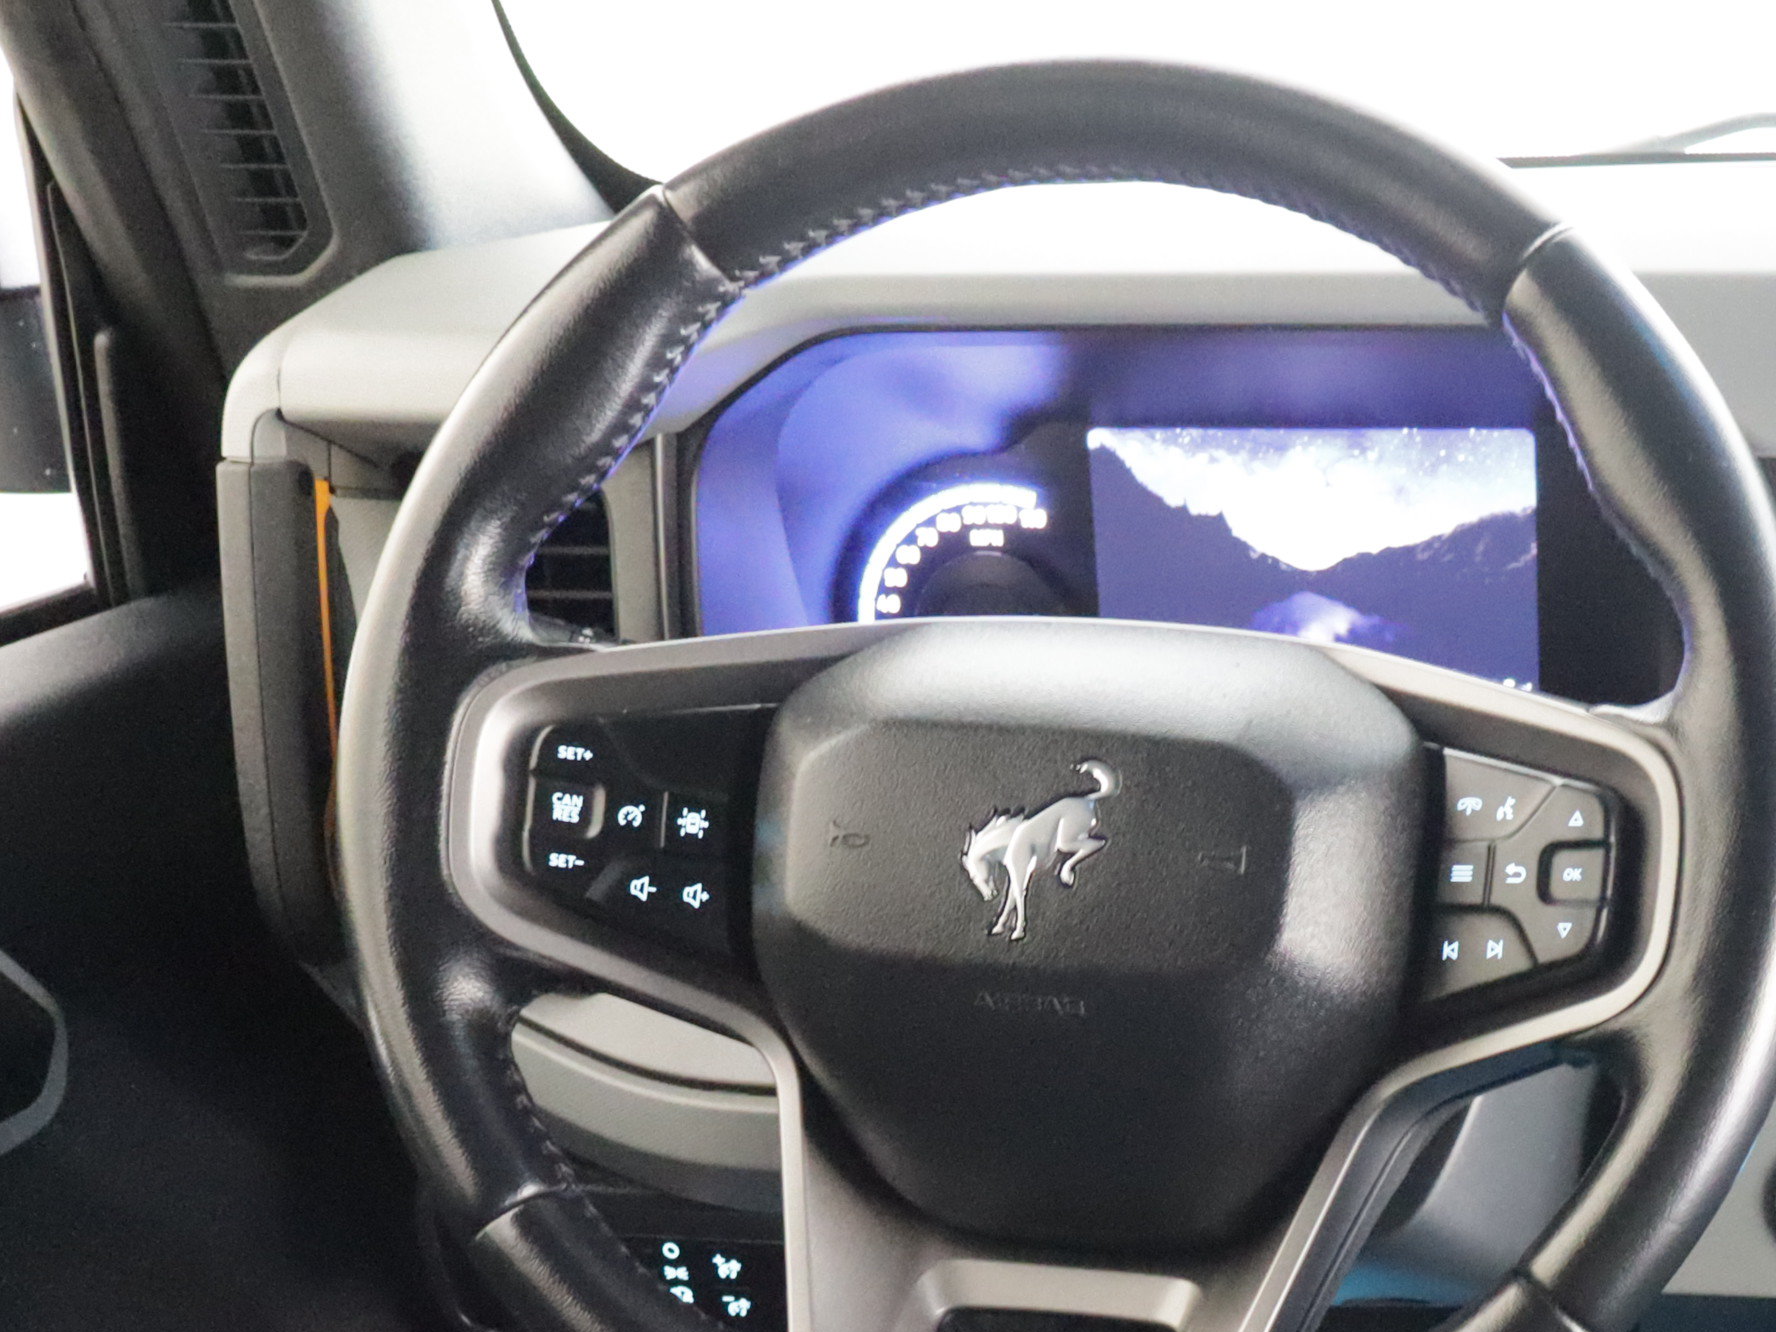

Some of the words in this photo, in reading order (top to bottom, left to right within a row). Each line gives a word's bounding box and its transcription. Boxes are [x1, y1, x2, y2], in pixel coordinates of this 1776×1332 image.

[557, 745, 594, 762] SET+
[552, 792, 583, 808] CAN
[552, 807, 580, 823] RES
[548, 853, 586, 869] SET-
[1562, 867, 1583, 882] OK
